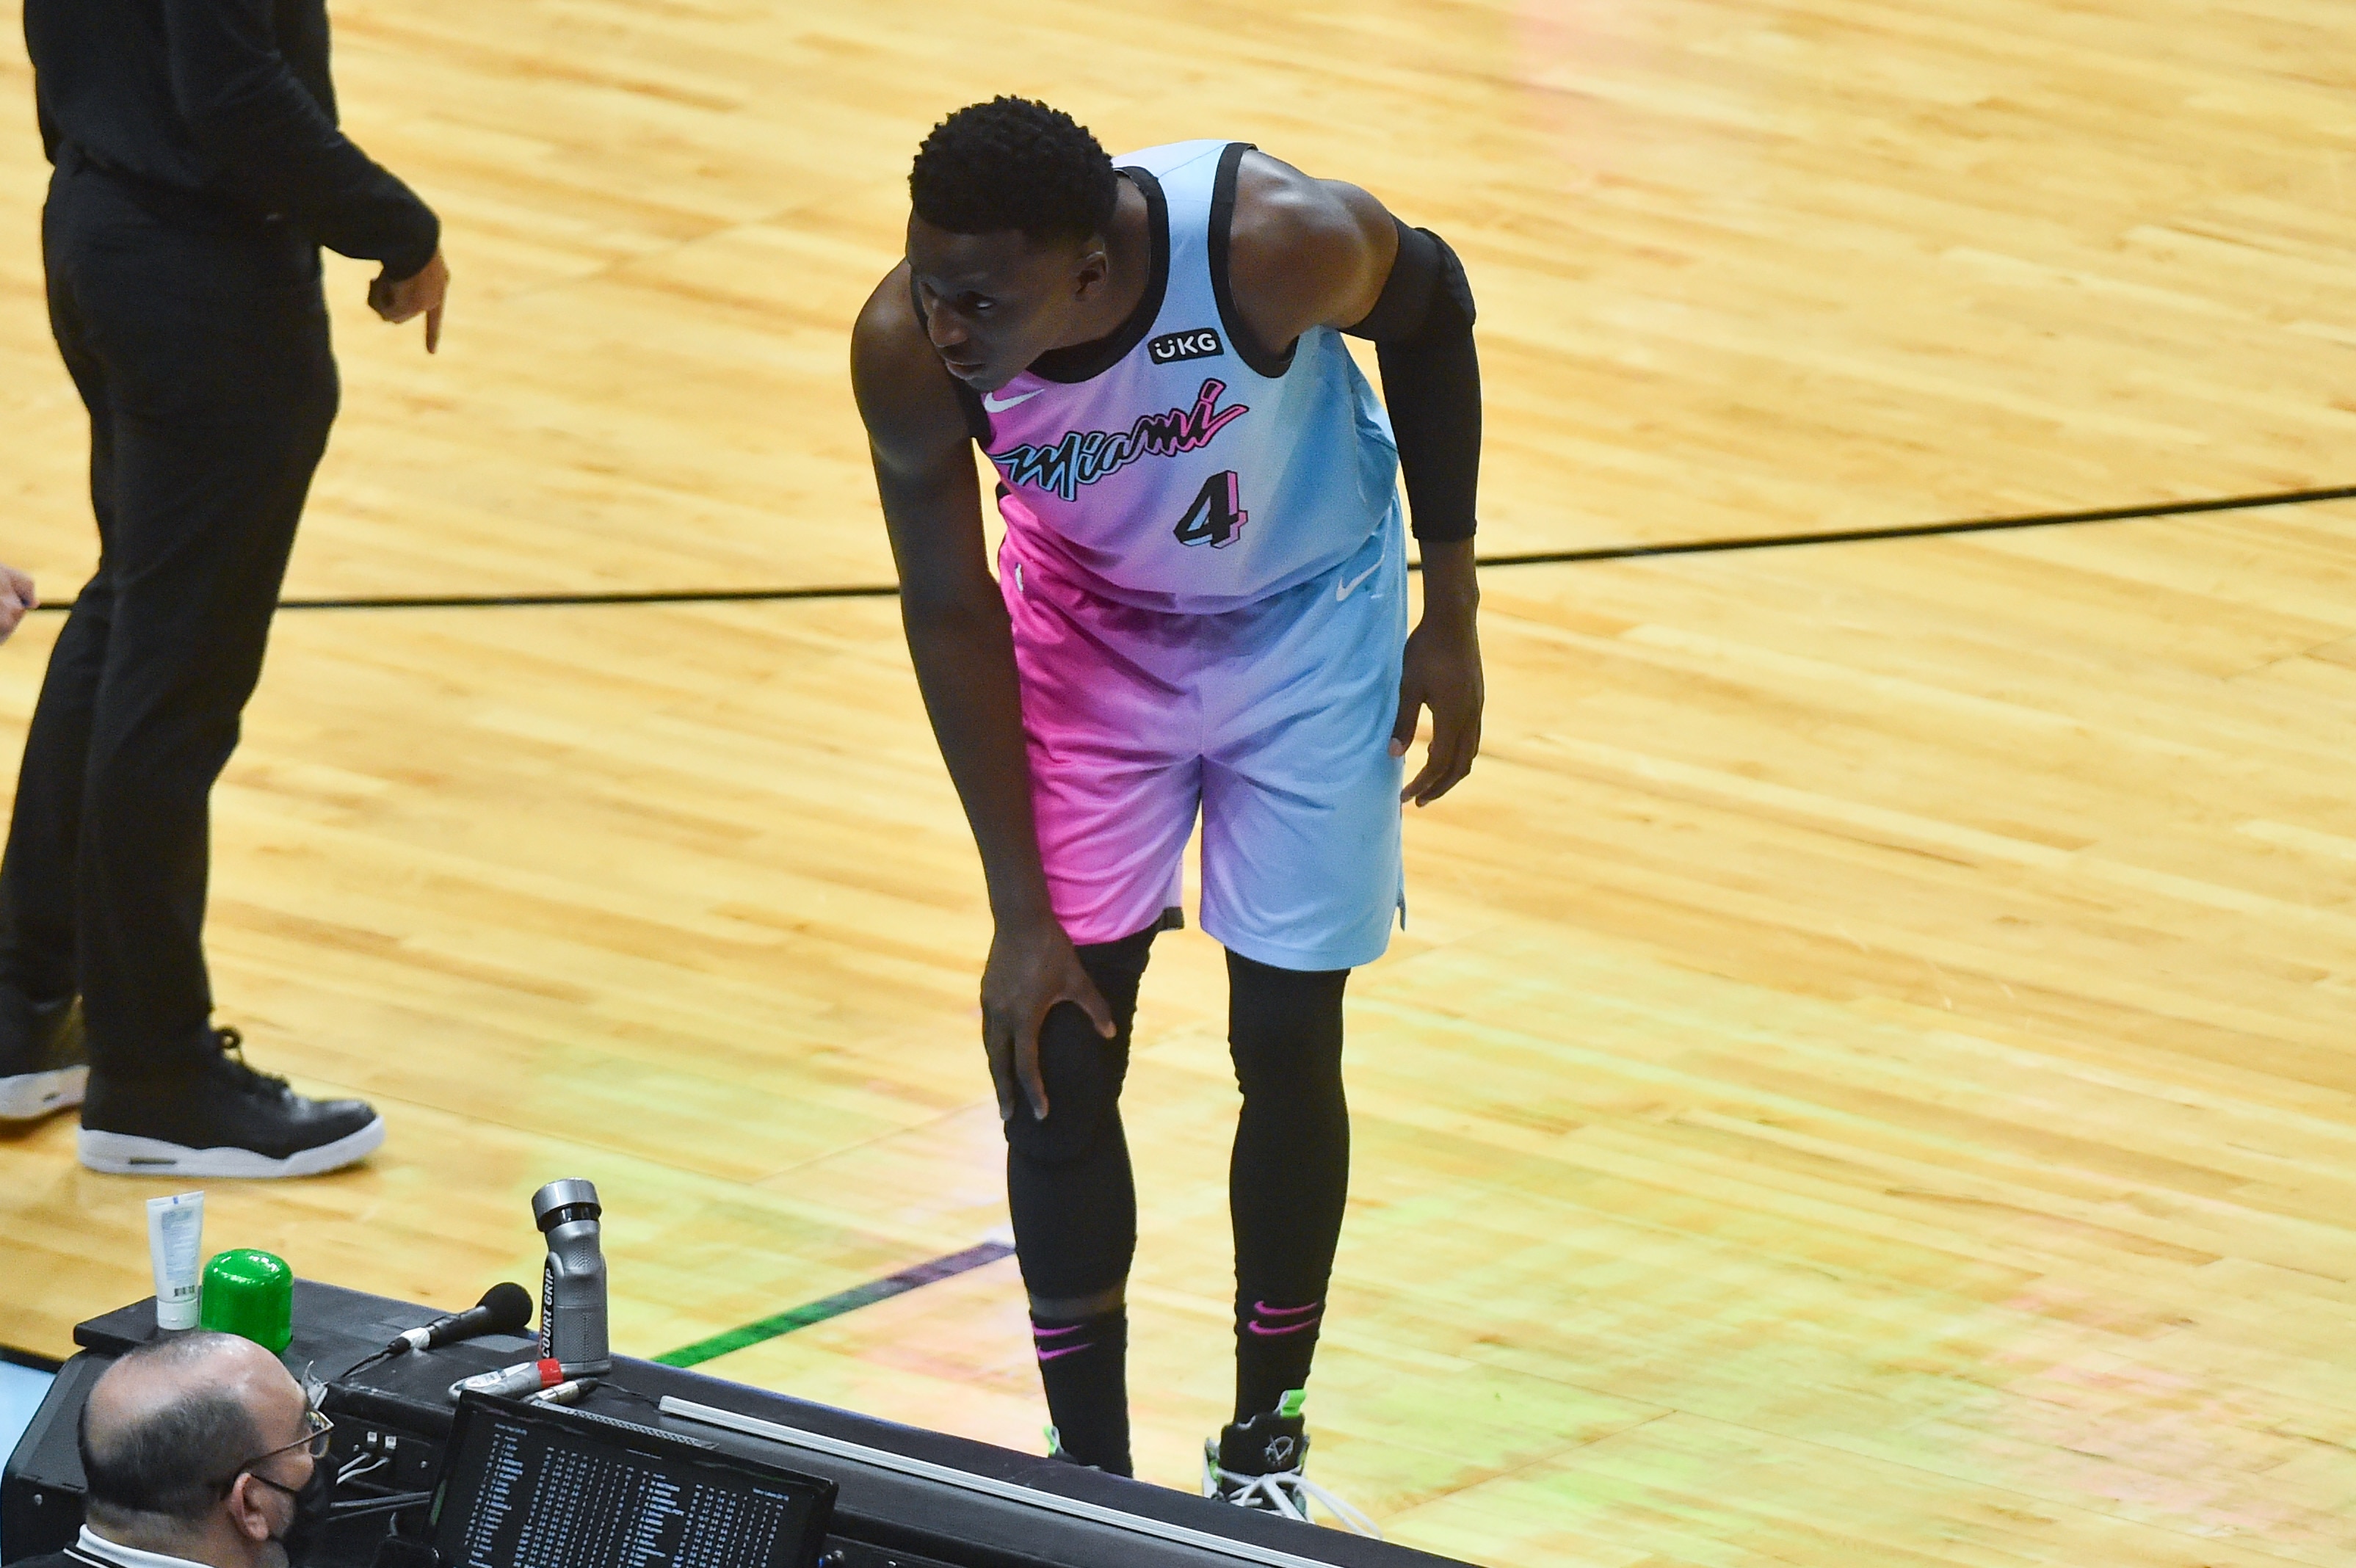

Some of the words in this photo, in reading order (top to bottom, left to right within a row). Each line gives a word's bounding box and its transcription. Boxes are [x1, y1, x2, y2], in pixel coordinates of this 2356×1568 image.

[990, 378, 1249, 501] Miami
[1174, 470, 1247, 548] 4
[544, 1268, 554, 1306] GRIP
[542, 1307, 552, 1358] COURT
